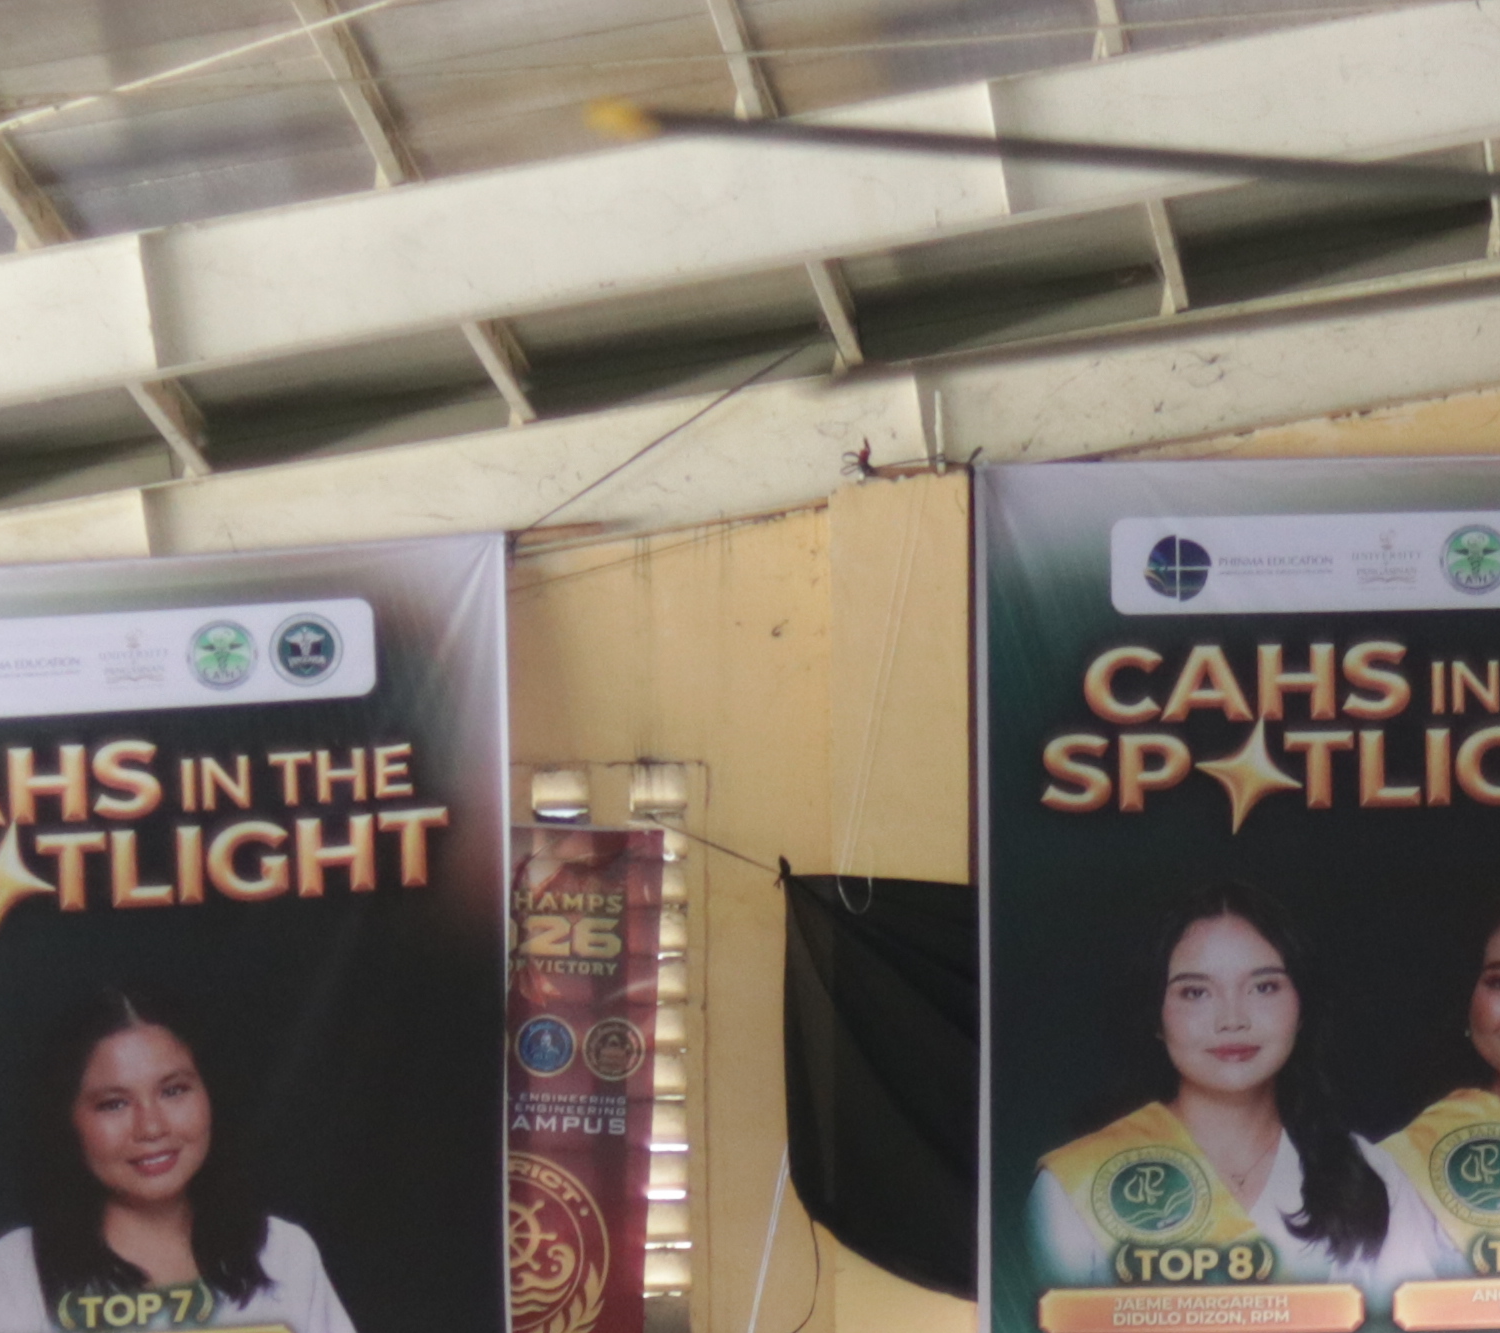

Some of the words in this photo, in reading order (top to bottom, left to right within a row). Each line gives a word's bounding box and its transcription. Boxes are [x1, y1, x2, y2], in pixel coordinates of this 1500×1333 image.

[1084, 642, 1409, 722] CAHS
[1430, 660, 1500, 714] IN
[180, 754, 252, 813] IN
[268, 743, 414, 806] THE
[534, 959, 618, 976] VICTORY
[1131, 1247, 1218, 1282] TOP
[1229, 1246, 1254, 1280] 8
[79, 1291, 165, 1329] TOP
[170, 1290, 194, 1326] 7
[1113, 1309, 1180, 1326] DIDULO
[1185, 1308, 1246, 1325] DIZON,
[1251, 1307, 1289, 1324] RPM
[1115, 1296, 1174, 1312] JAEME
[1181, 1294, 1288, 1311] MARGARETH
